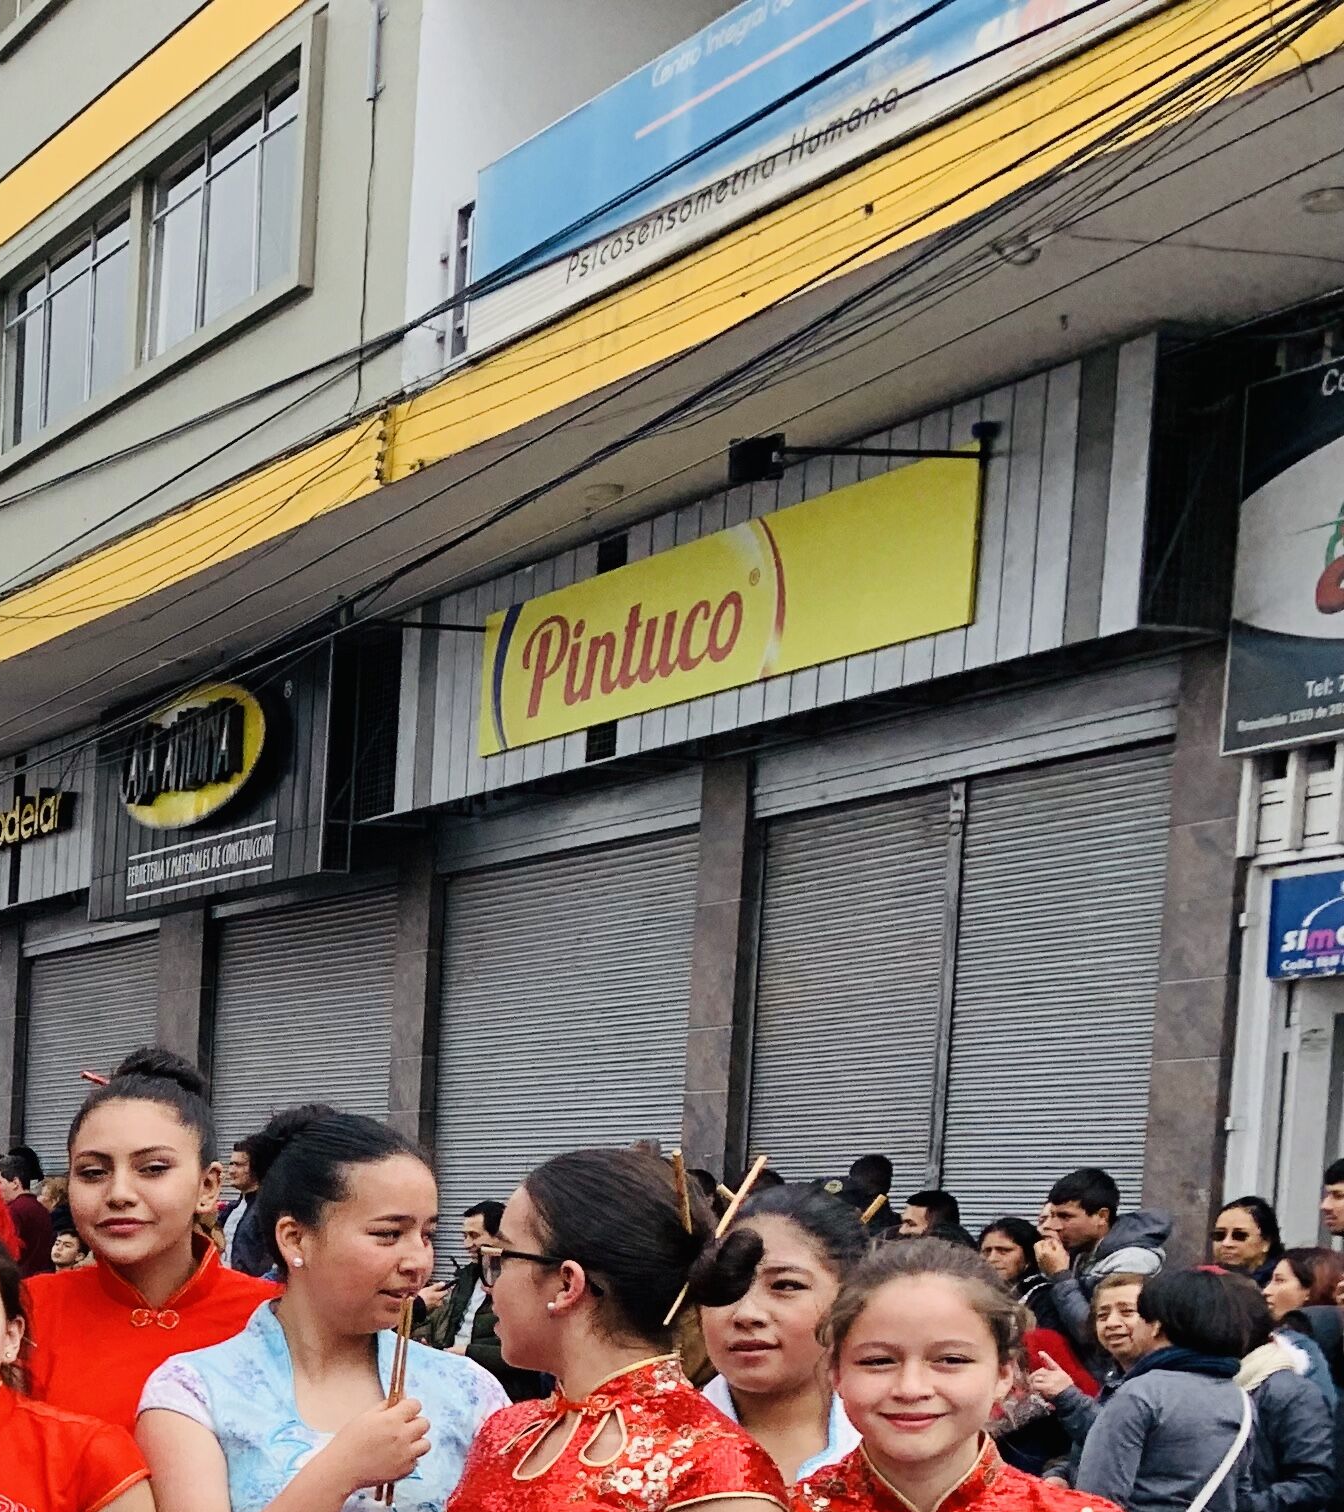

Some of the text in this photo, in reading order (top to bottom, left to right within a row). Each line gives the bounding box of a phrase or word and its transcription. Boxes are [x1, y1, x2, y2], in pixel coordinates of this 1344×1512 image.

[787, 87, 900, 166] Humana
[522, 590, 743, 719] Pintuco
[211, 844, 221, 869] DE
